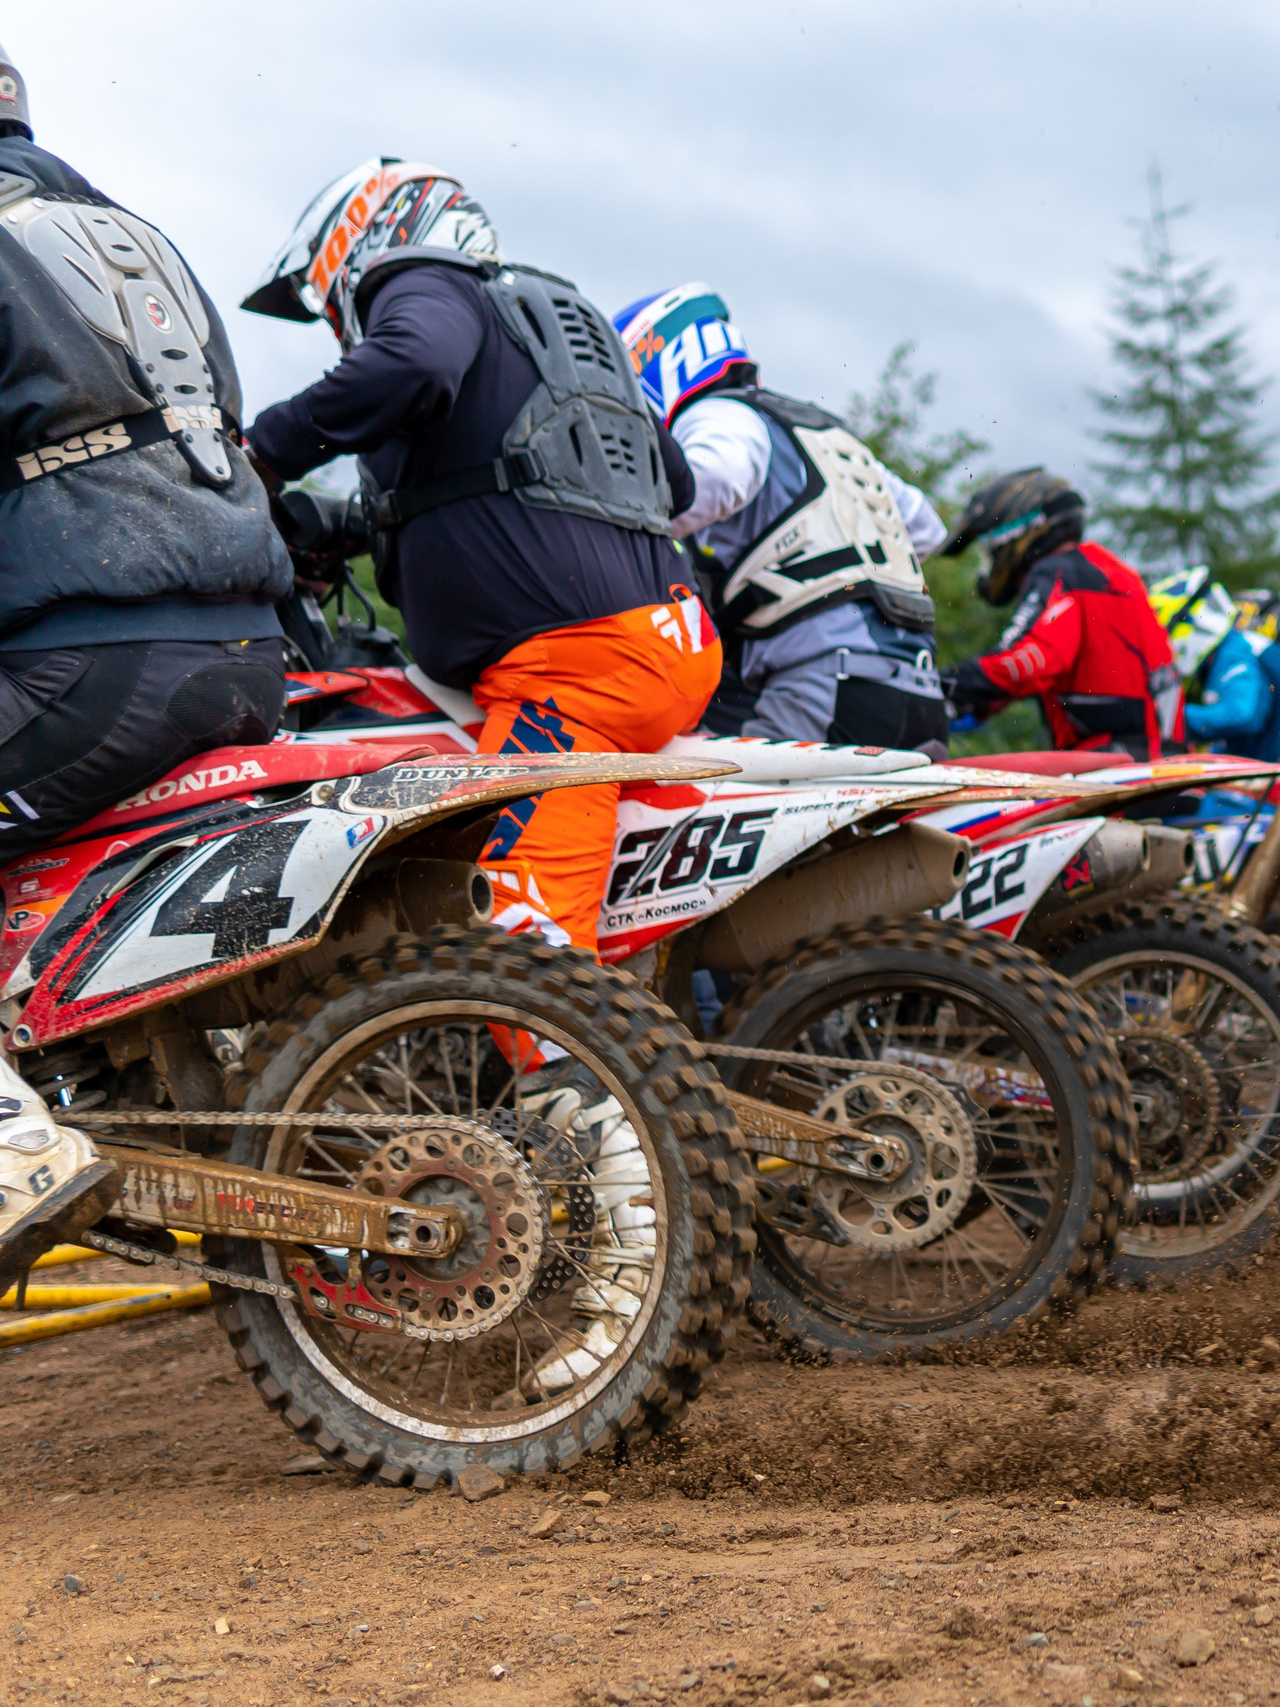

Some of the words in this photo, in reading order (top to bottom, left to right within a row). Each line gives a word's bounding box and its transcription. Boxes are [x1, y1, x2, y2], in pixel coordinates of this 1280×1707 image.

[114, 760, 268, 813] HONDA
[149, 818, 313, 959] 4
[606, 807, 780, 907] 285
[933, 843, 1030, 921] 22
[606, 914, 635, 929] СТК
